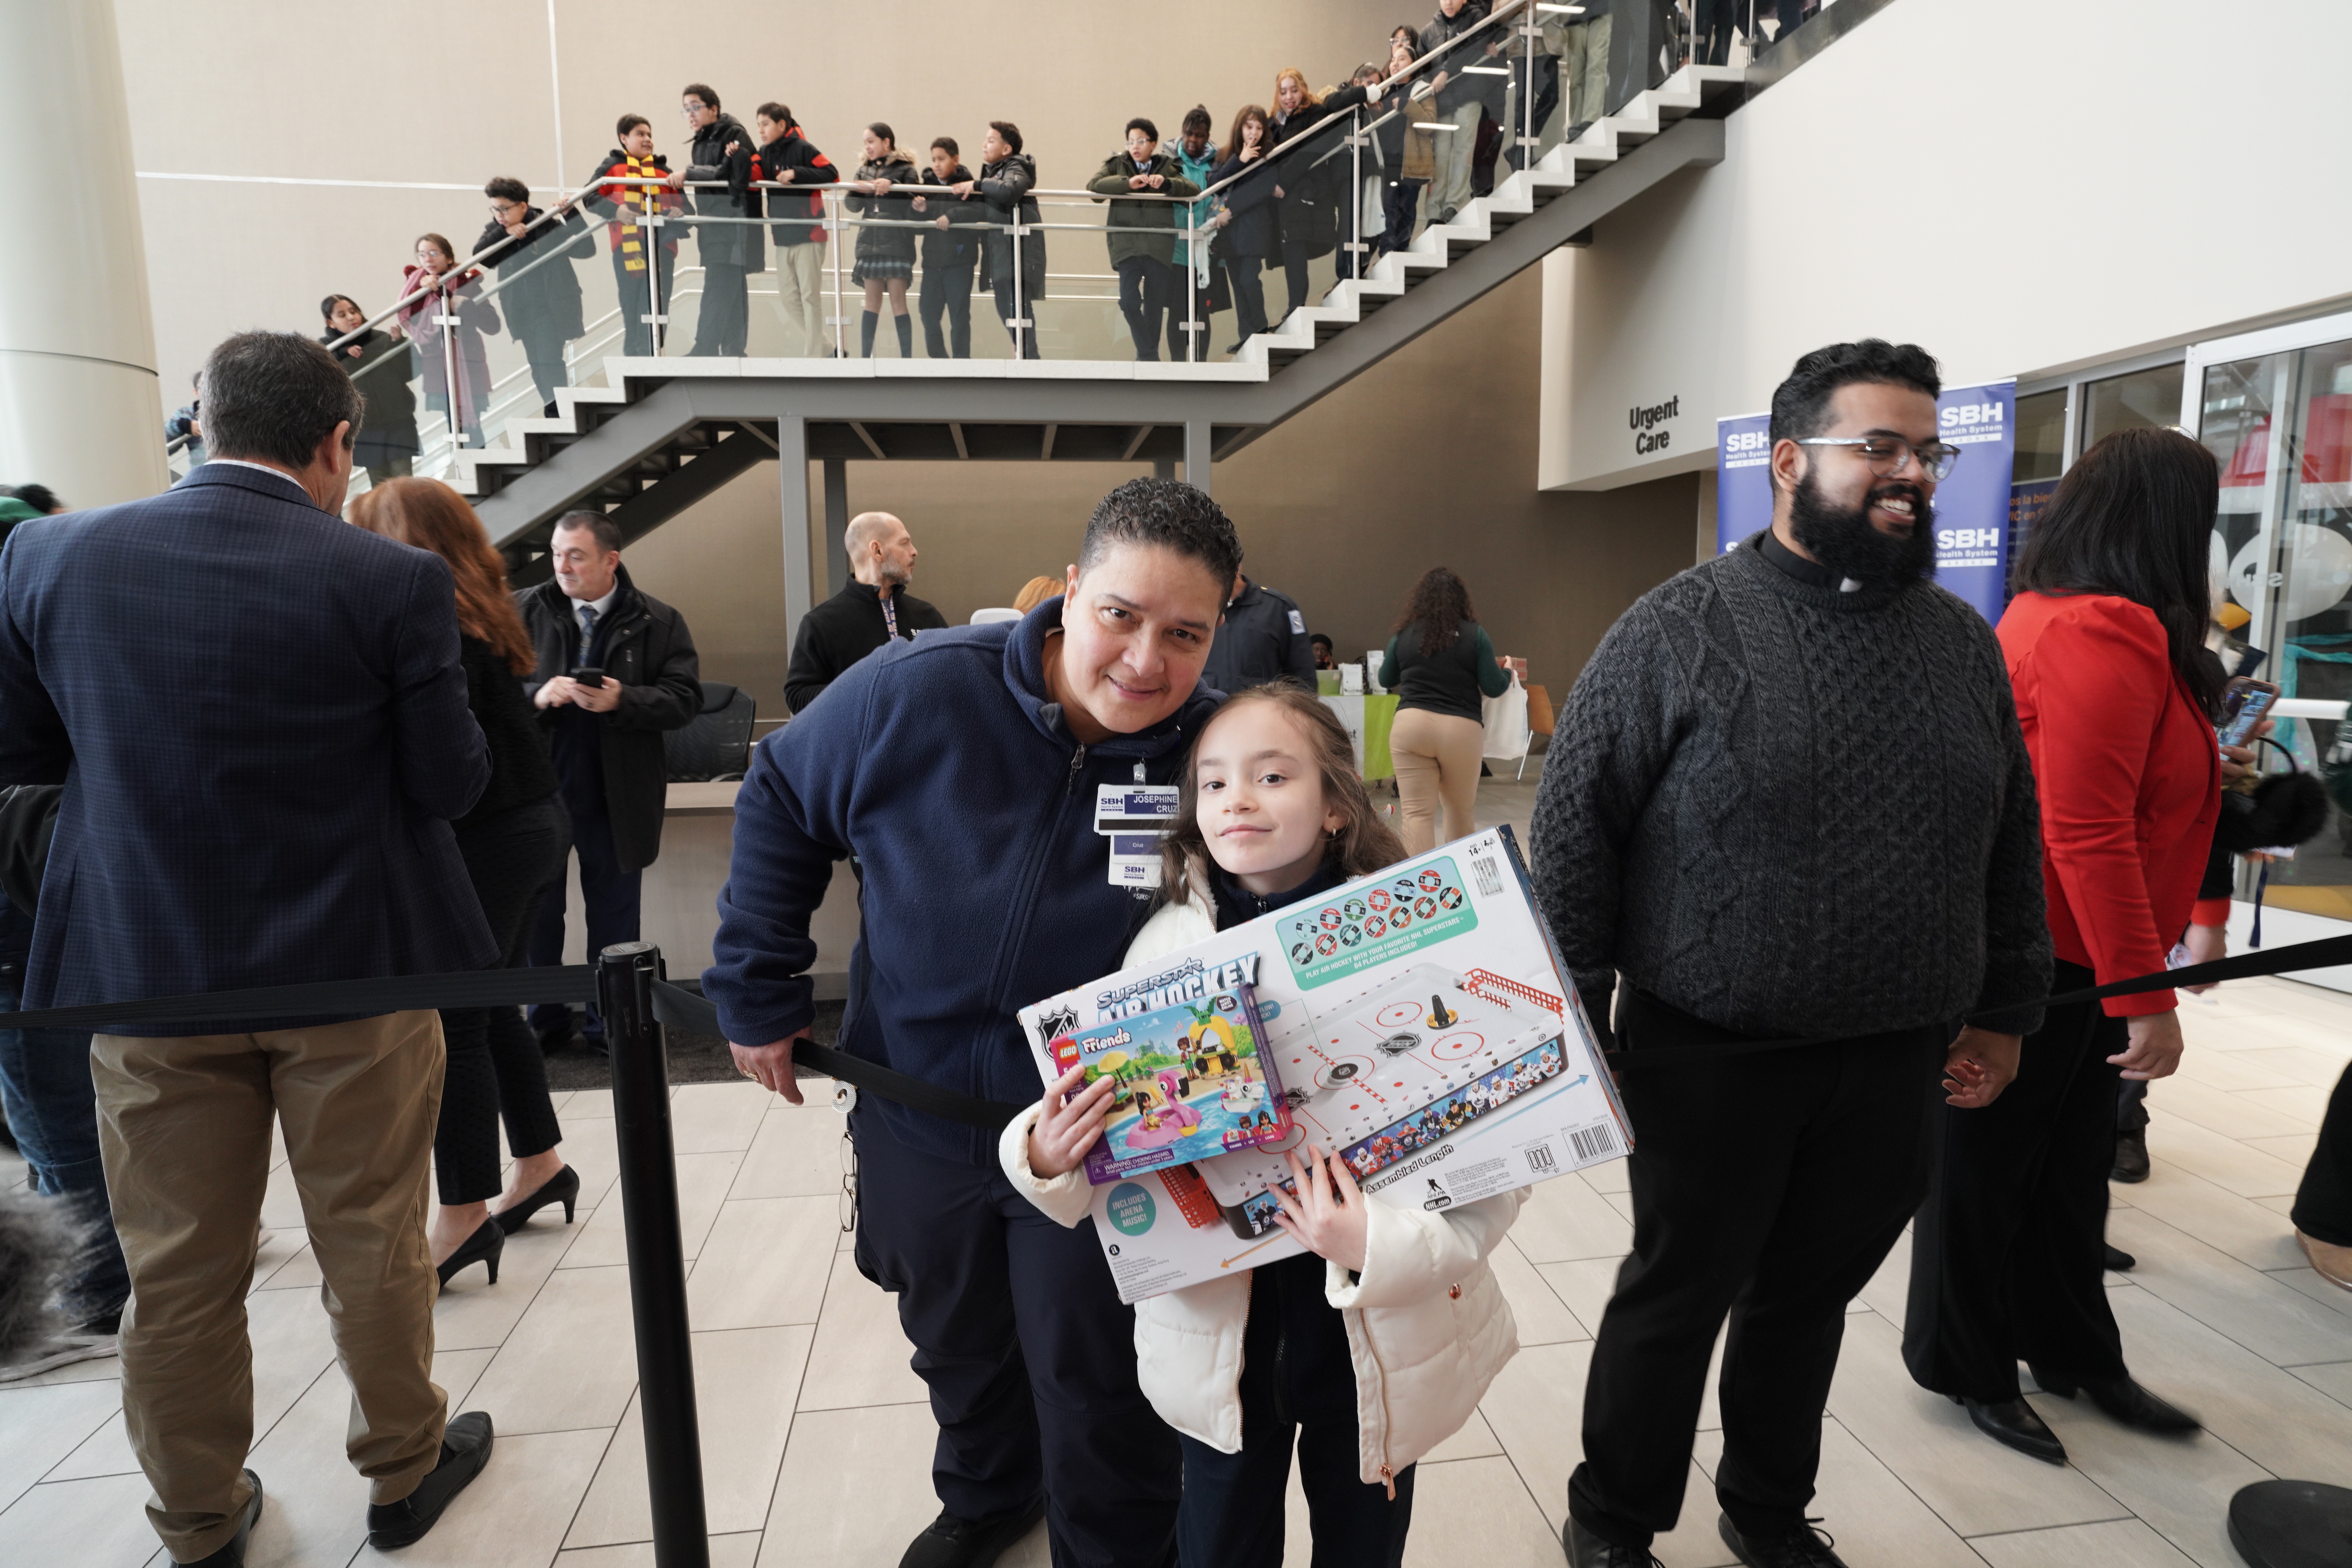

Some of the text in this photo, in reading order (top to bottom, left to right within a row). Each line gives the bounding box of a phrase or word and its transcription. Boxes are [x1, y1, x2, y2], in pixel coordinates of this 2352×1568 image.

[1630, 395, 1679, 430] Urgent
[1940, 402, 2003, 427] SBH
[1939, 424, 2003, 436] Health System
[1636, 431, 1670, 455] Care
[1938, 528, 1999, 549] SBH
[1133, 795, 1178, 804] JOSEPHINE
[1468, 846, 1482, 857] 14+
[1305, 917, 1460, 979] PLAY AIR HOCKEY WITH YOUR FAVORITE NHL SUPERSTARS
[1353, 940, 1418, 969] 64 PLAYERS INCLUDED!
[1097, 957, 1204, 1009] SUPERSTAR
[1147, 951, 1259, 1010] HOCKEY
[1081, 1027, 1132, 1054] Friends
[1060, 1046, 1077, 1058] LEGO
[1104, 1159, 1132, 1171] WARNING:
[1132, 1154, 1152, 1164] CHOKING
[1366, 1159, 1419, 1194] Assembled
[1418, 1144, 1454, 1168] Length
[1112, 1193, 1146, 1210] INCLUDES
[1425, 1197, 1450, 1210] NHL.com
[1427, 1191, 1446, 1199] NHLPA
[1120, 1204, 1144, 1218] ARENA
[1122, 1213, 1147, 1228] MUSIC!
